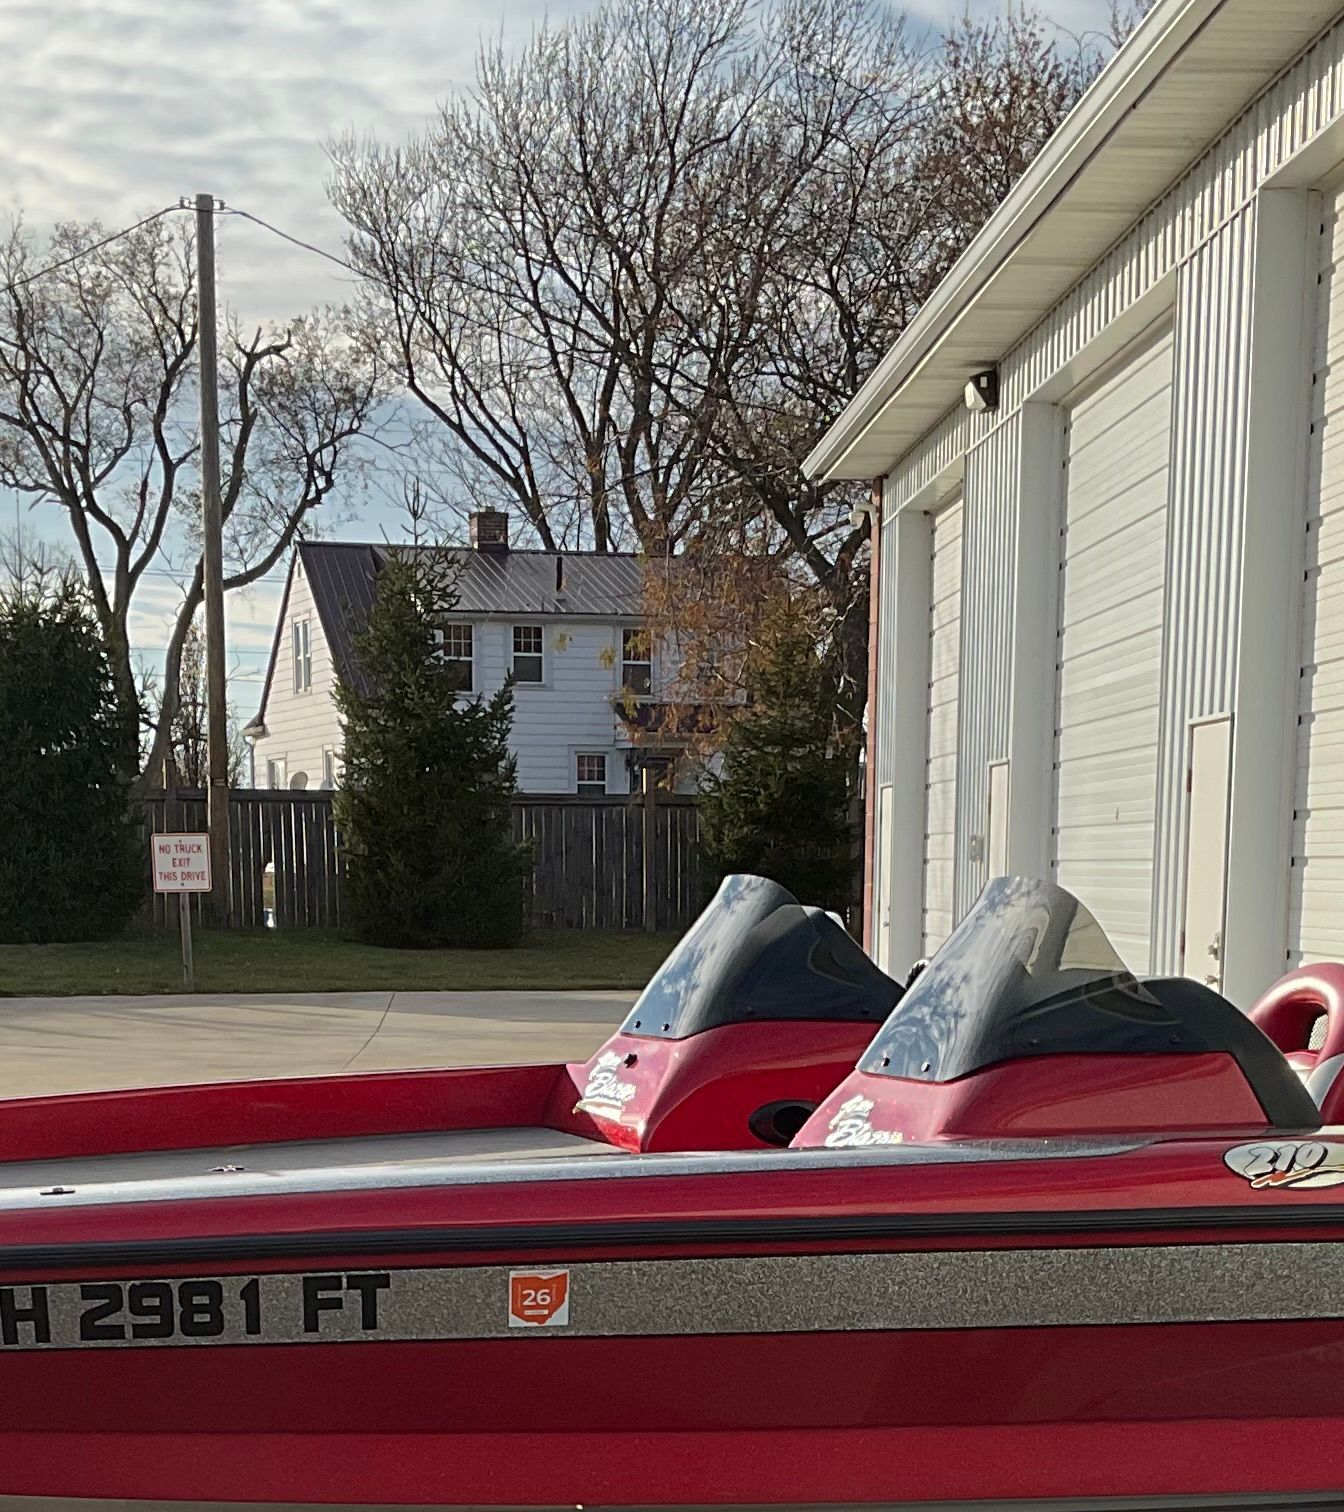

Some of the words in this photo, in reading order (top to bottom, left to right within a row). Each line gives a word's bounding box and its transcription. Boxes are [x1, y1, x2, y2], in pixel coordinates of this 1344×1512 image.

[159, 844, 171, 854] NO
[175, 843, 202, 854] TRUCK
[172, 858, 190, 867] EXIT
[159, 872, 177, 881] THIS
[181, 871, 206, 881] DRIVE
[1242, 1142, 1328, 1176] 210
[522, 1289, 551, 1306] 26
[79, 1277, 262, 1341] 2981
[302, 1272, 391, 1333] FT
